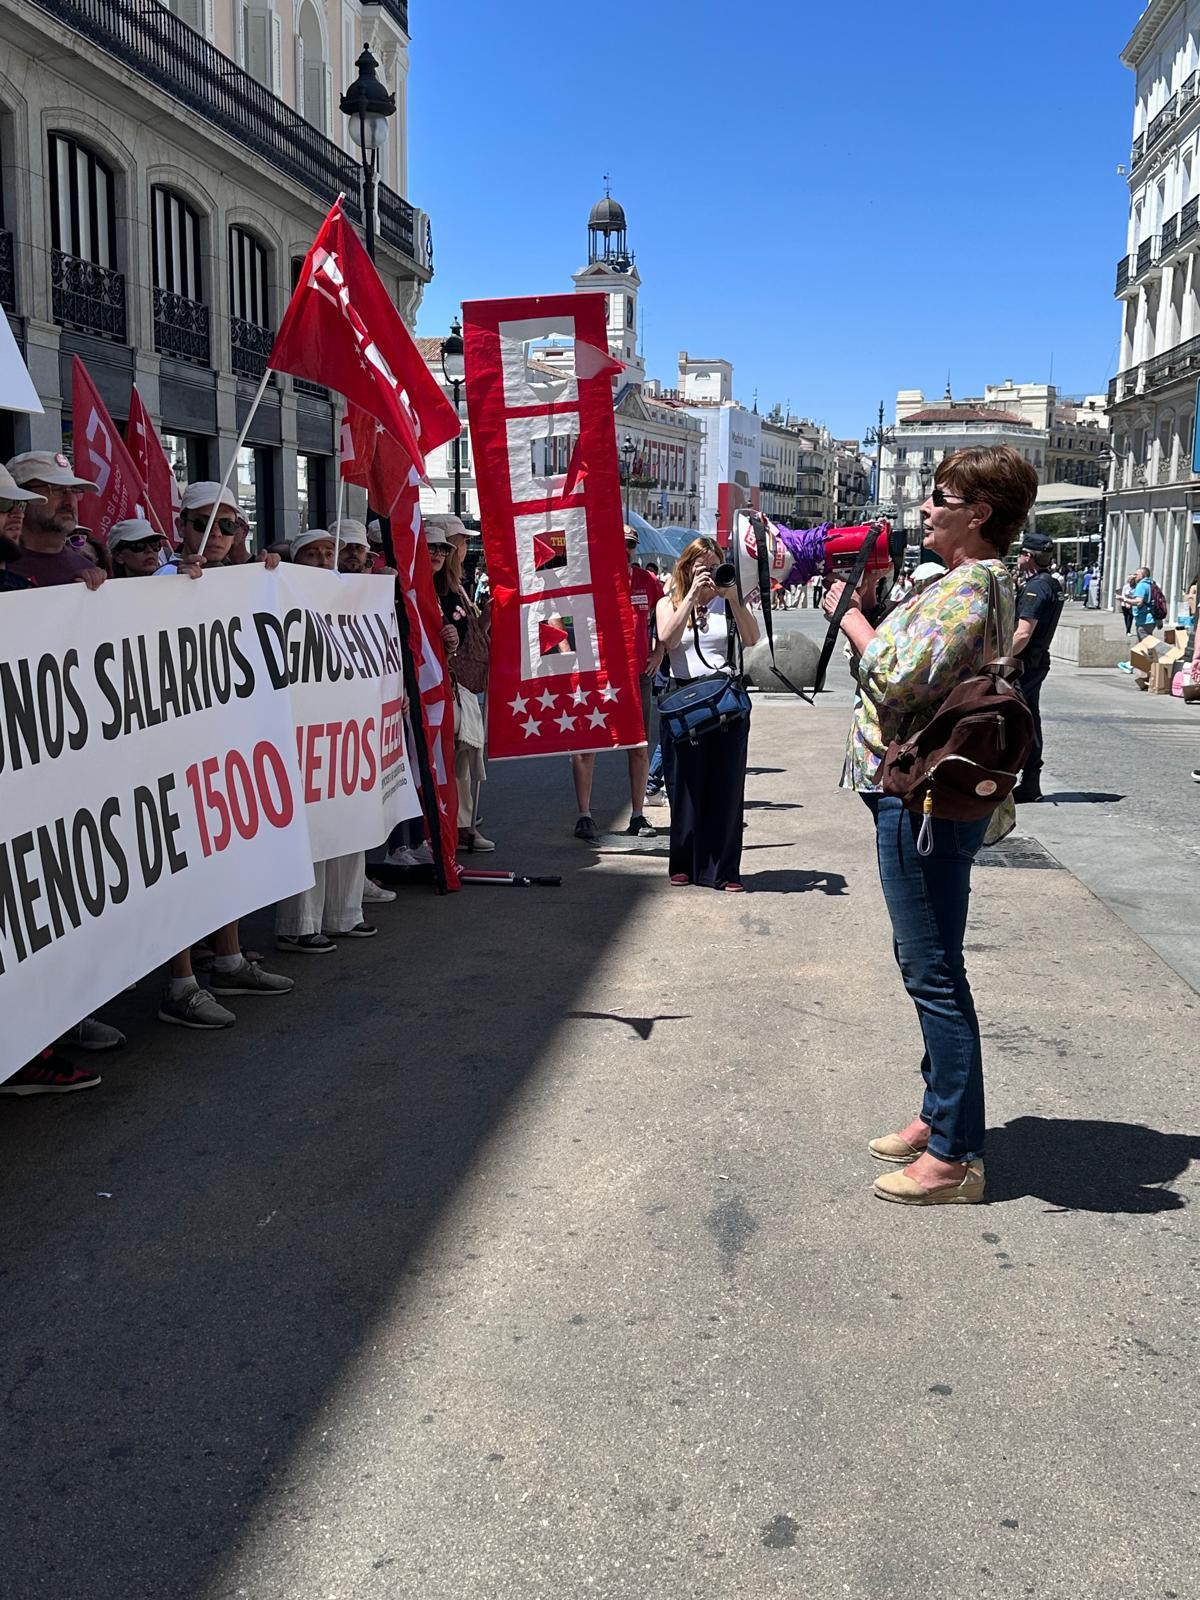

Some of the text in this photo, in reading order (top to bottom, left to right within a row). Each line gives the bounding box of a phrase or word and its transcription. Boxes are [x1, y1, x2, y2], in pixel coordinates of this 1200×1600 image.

[0, 647, 89, 777] NOS
[94, 616, 255, 741] SALARIOS
[252, 608, 355, 690] DGNOS
[133, 773, 189, 889] DE
[185, 740, 294, 859] 1500
